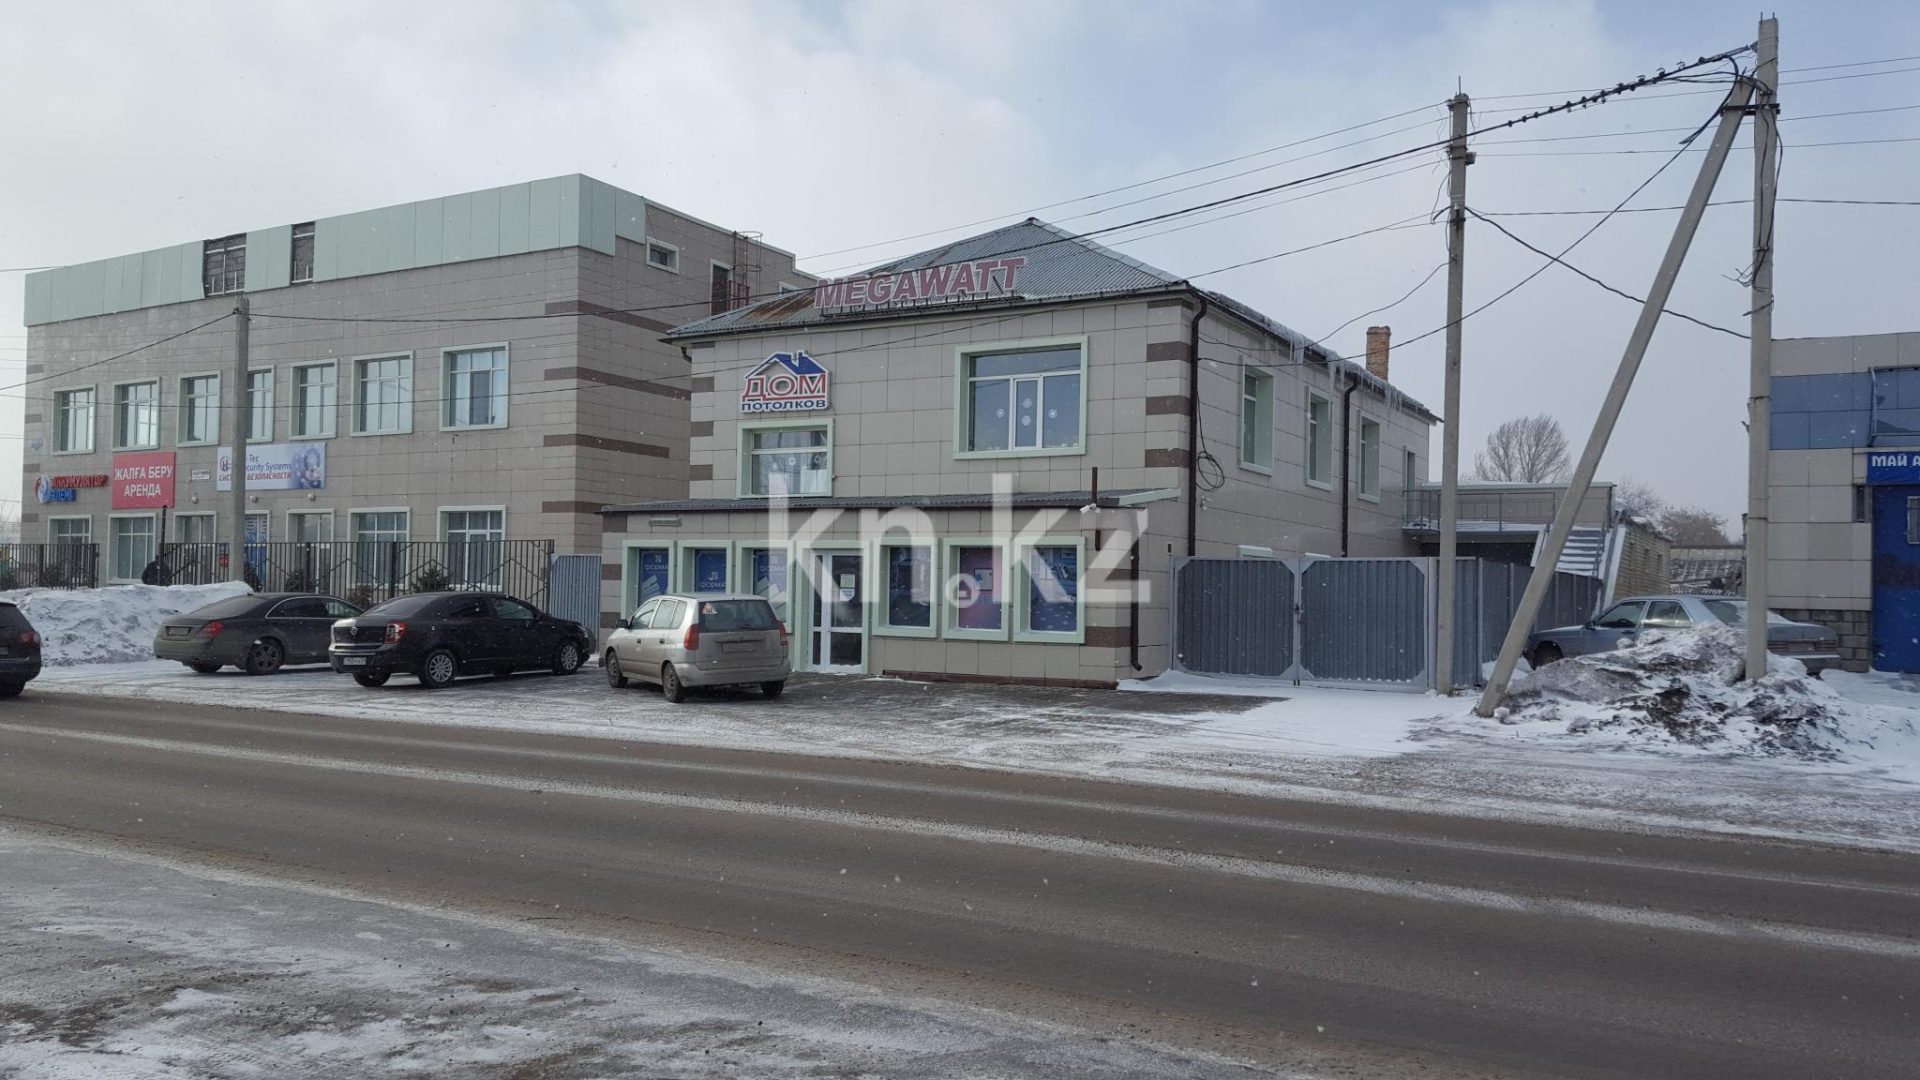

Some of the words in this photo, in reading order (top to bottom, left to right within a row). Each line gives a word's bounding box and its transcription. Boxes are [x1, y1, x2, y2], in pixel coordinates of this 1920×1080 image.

[814, 257, 1026, 308] MEGAWATT
[741, 374, 827, 402] ДОМ
[742, 400, 826, 411] ПОТОЛКОВ
[246, 463, 264, 472] curity
[265, 462, 292, 472] Systems
[1872, 453, 1907, 467] МАЙ
[148, 465, 173, 479] БЕРУ
[124, 484, 161, 498] АРЕНДА
